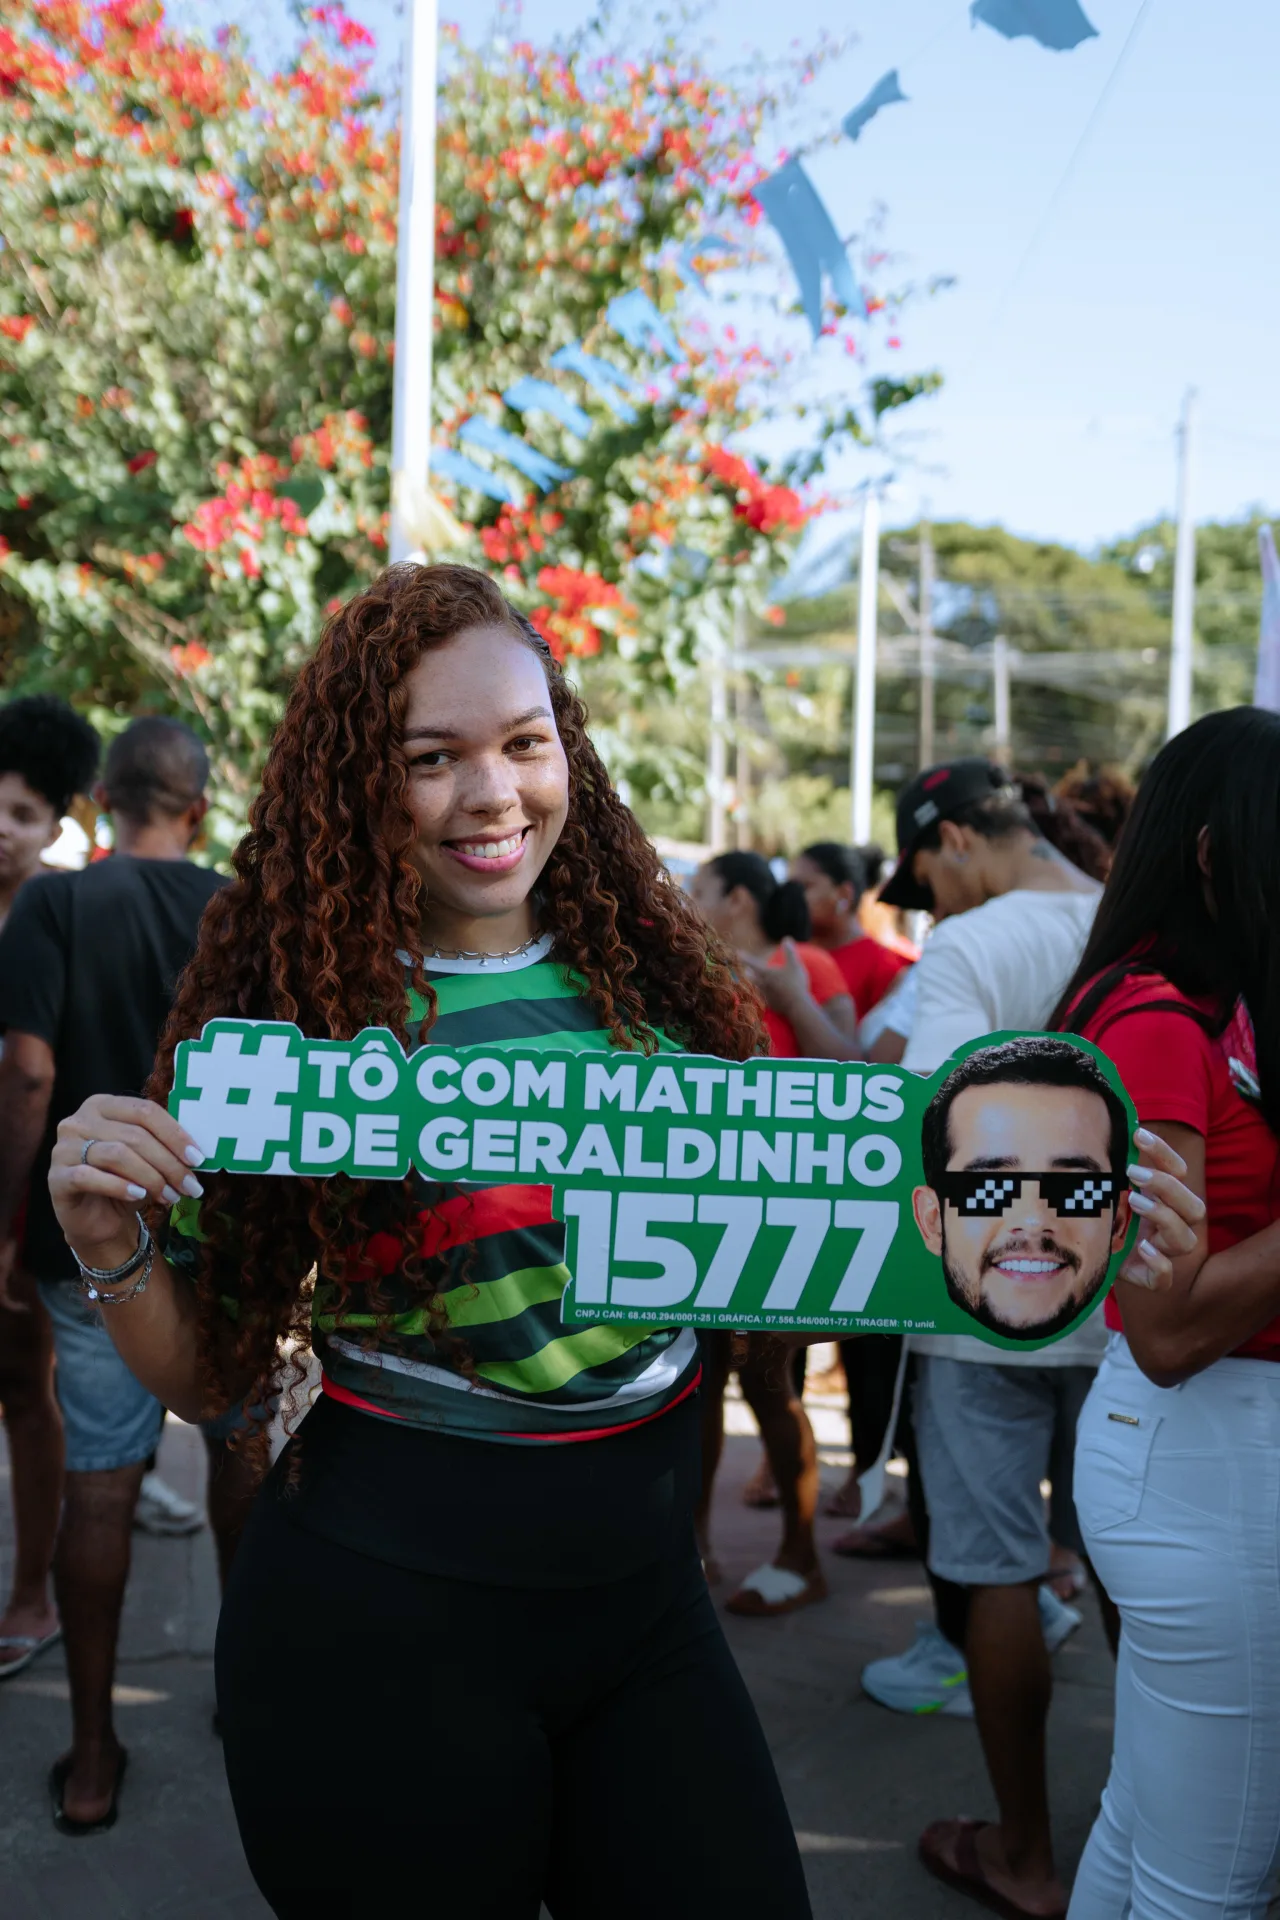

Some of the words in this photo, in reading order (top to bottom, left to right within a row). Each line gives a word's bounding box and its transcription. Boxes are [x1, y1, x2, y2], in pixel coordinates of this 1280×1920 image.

[416, 1056, 566, 1109] COM
[584, 1063, 905, 1122] MATHEUS
[300, 1111, 400, 1168] DE
[418, 1116, 902, 1188] GERALDINHO
[563, 1189, 899, 1312] 15777
[574, 1308, 600, 1319] CNPJ
[602, 1309, 626, 1320] CAN:
[718, 1313, 763, 1325] GRÁFICA:
[855, 1317, 900, 1328] TIRAGEM:
[903, 1319, 914, 1329] 10
[915, 1319, 937, 1330] unid.
